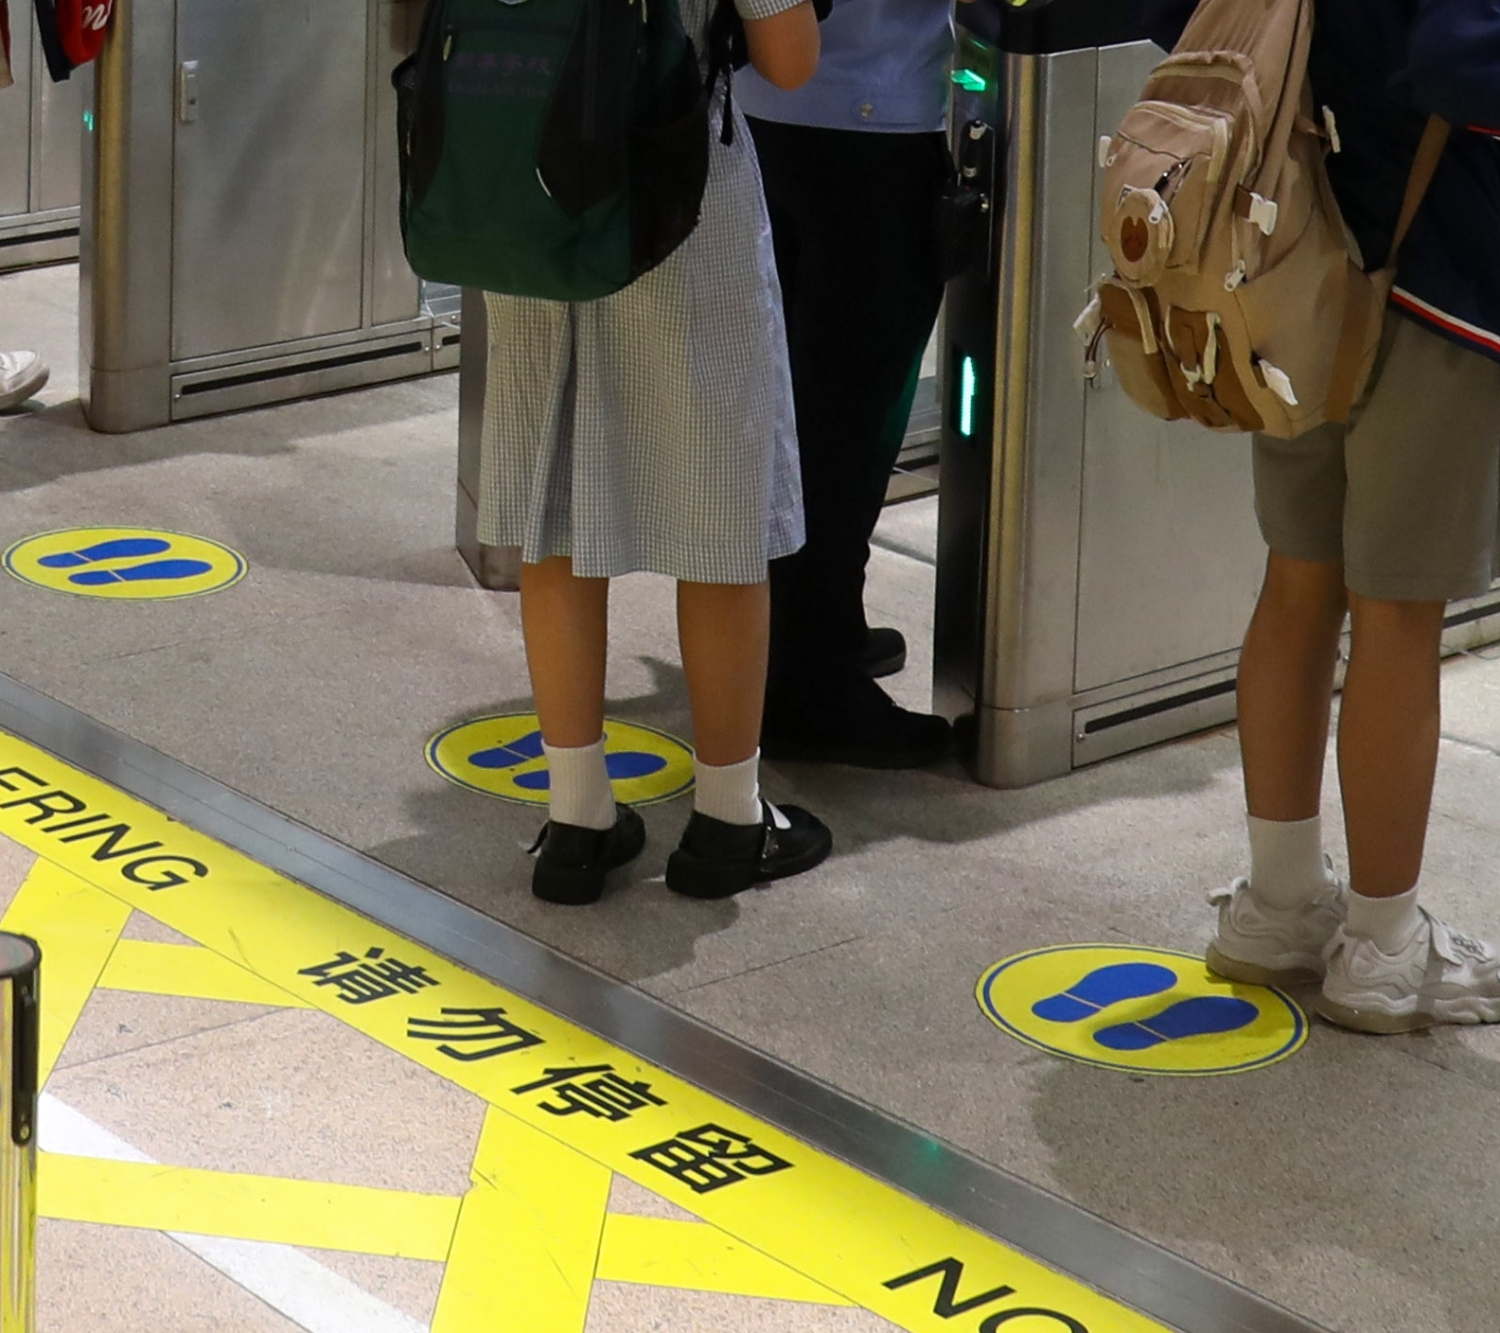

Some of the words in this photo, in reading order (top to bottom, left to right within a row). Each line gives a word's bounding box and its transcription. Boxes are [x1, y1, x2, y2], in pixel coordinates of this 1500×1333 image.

[295, 943, 792, 1194] 请勿停留
[884, 1255, 1135, 1333] NO
